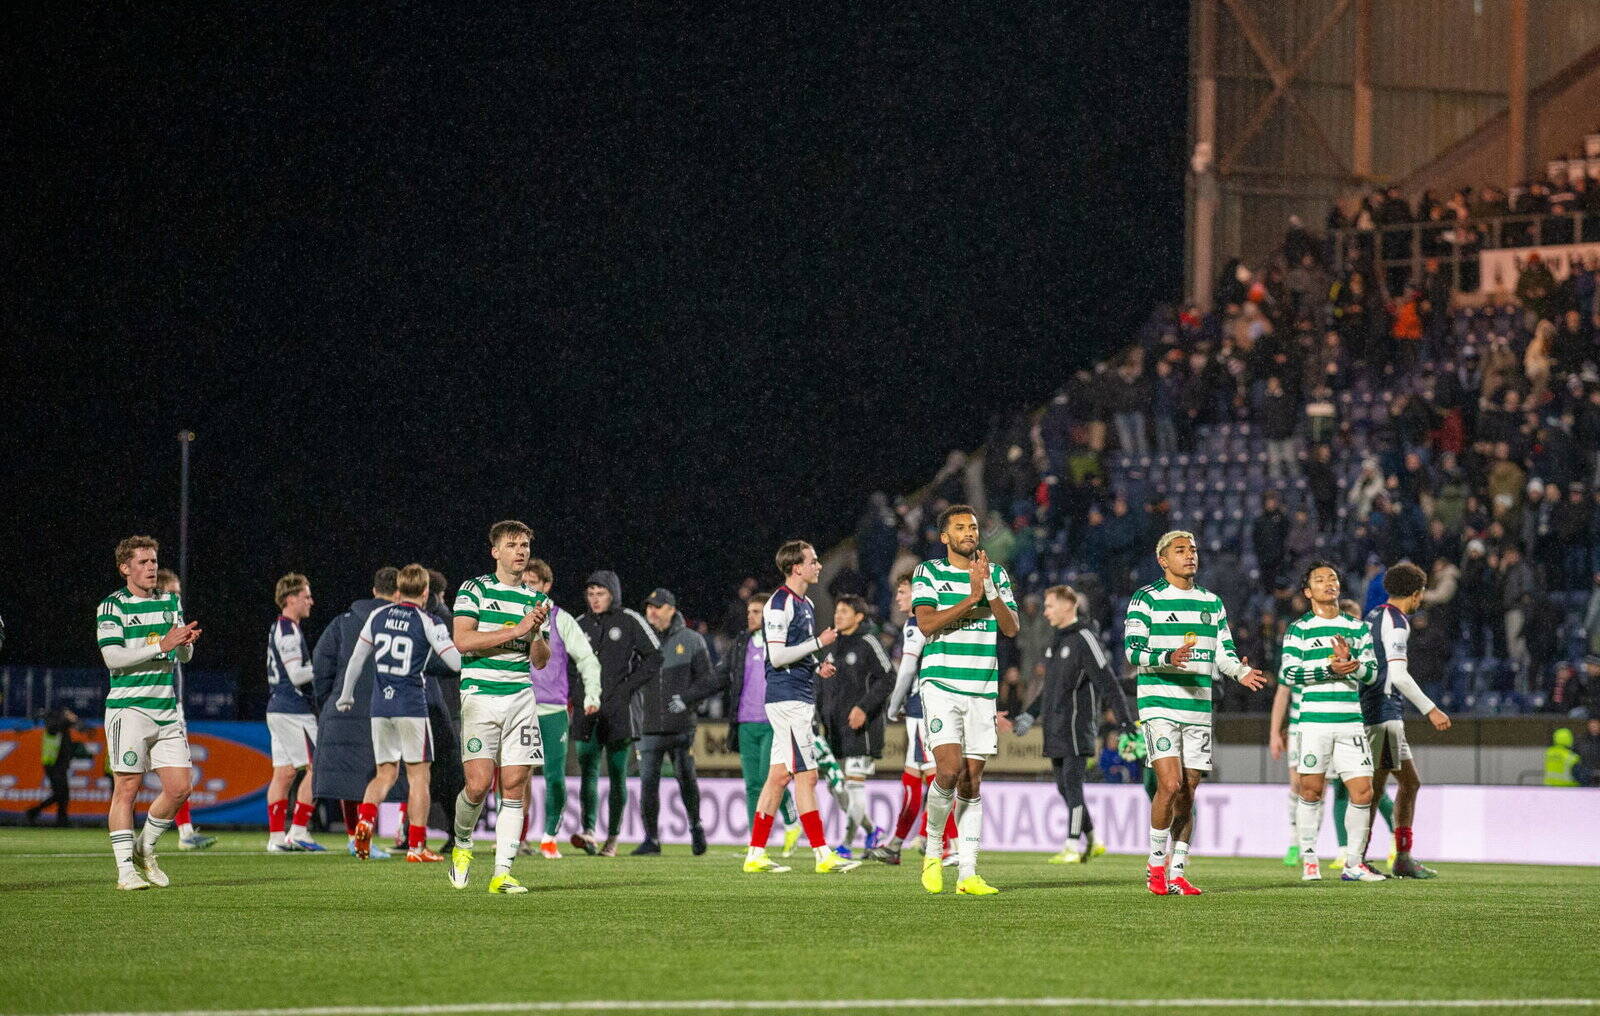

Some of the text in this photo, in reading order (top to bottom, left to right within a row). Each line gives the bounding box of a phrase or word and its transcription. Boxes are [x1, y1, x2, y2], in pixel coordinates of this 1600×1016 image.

[385, 618, 410, 632] MILLER
[374, 633, 413, 677] 29
[520, 725, 541, 746] 63
[1201, 733, 1210, 753] 2
